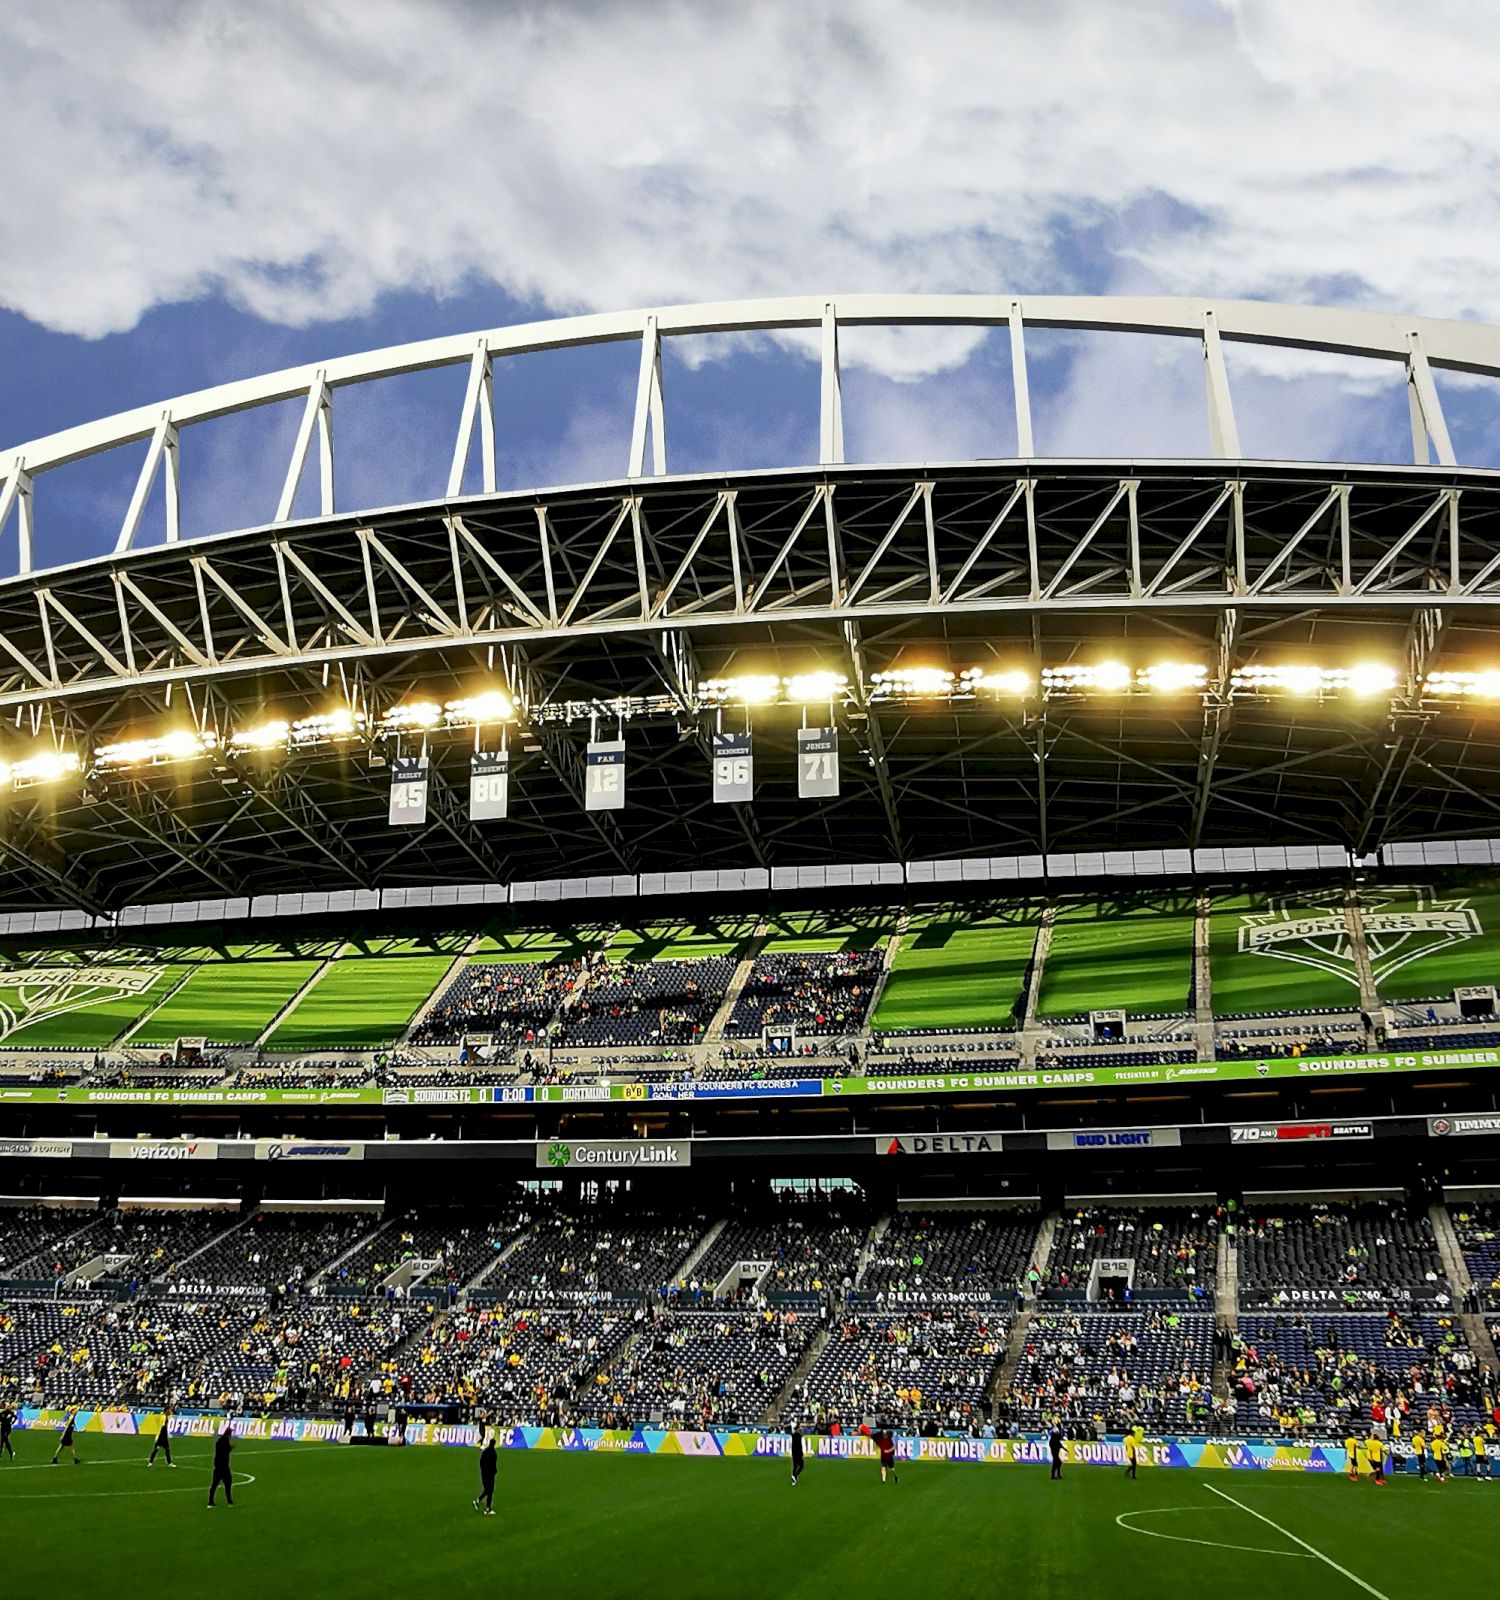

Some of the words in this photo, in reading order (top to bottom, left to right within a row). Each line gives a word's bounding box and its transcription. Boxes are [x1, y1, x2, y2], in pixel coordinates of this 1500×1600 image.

[806, 742, 831, 750] JONES
[598, 755, 615, 763] FAN
[717, 760, 749, 785] 96
[805, 755, 833, 780] 71
[592, 767, 618, 792] 12
[395, 784, 423, 808] 45
[474, 779, 504, 802] 80
[1426, 919, 1464, 929] FC
[117, 976, 142, 987] FC
[1298, 1058, 1389, 1072] SOUNDERS
[1395, 1056, 1416, 1066] FC
[1422, 1052, 1498, 1065] SUMMER
[697, 1082, 742, 1090] SOUNDERS
[744, 1081, 756, 1089] FC
[757, 1081, 790, 1089] SCORES
[791, 1080, 798, 1088] A
[867, 1078, 945, 1090] SOUNDERS
[950, 1077, 968, 1087] FC
[973, 1075, 1038, 1086] SUMMER
[1042, 1073, 1095, 1084] CAMPS
[89, 1092, 151, 1100] SOUNDERS
[155, 1092, 169, 1100] FC
[173, 1092, 223, 1101] SUMMER
[226, 1092, 267, 1101] CAMPS
[414, 1090, 458, 1102] SOUNDERS
[460, 1090, 471, 1101] FC
[502, 1089, 525, 1101] 0:00
[562, 1088, 611, 1099] DORTMUND
[625, 1085, 642, 1097] BVB
[1232, 1127, 1260, 1140] 710
[1333, 1126, 1369, 1134] SEATTLE
[913, 1136, 992, 1152] DELTA
[1076, 1134, 1106, 1146] BUD
[1108, 1133, 1150, 1145] LIGHT
[130, 1144, 189, 1159] verizon
[575, 1145, 678, 1164] CenturyLink
[1101, 1262, 1127, 1270] 212
[179, 1285, 212, 1294] DELTA
[519, 1290, 555, 1300] DLTA
[1292, 1290, 1337, 1300] DELTA
[888, 1292, 928, 1301] DELTA
[168, 1418, 215, 1435] OFFICIAL
[218, 1419, 266, 1436] MEDICAL
[271, 1421, 299, 1438] CARE
[500, 1428, 514, 1445] FC
[582, 1438, 613, 1451] Virginia
[614, 1438, 644, 1449] Mason
[756, 1436, 814, 1455] OFFICAL
[818, 1437, 876, 1456] MEDICAL
[919, 1440, 985, 1459] PROVIDER
[990, 1441, 1006, 1459] OF
[1153, 1445, 1171, 1463] FC
[1251, 1456, 1291, 1467] Virginia
[1292, 1457, 1327, 1468] Mason
